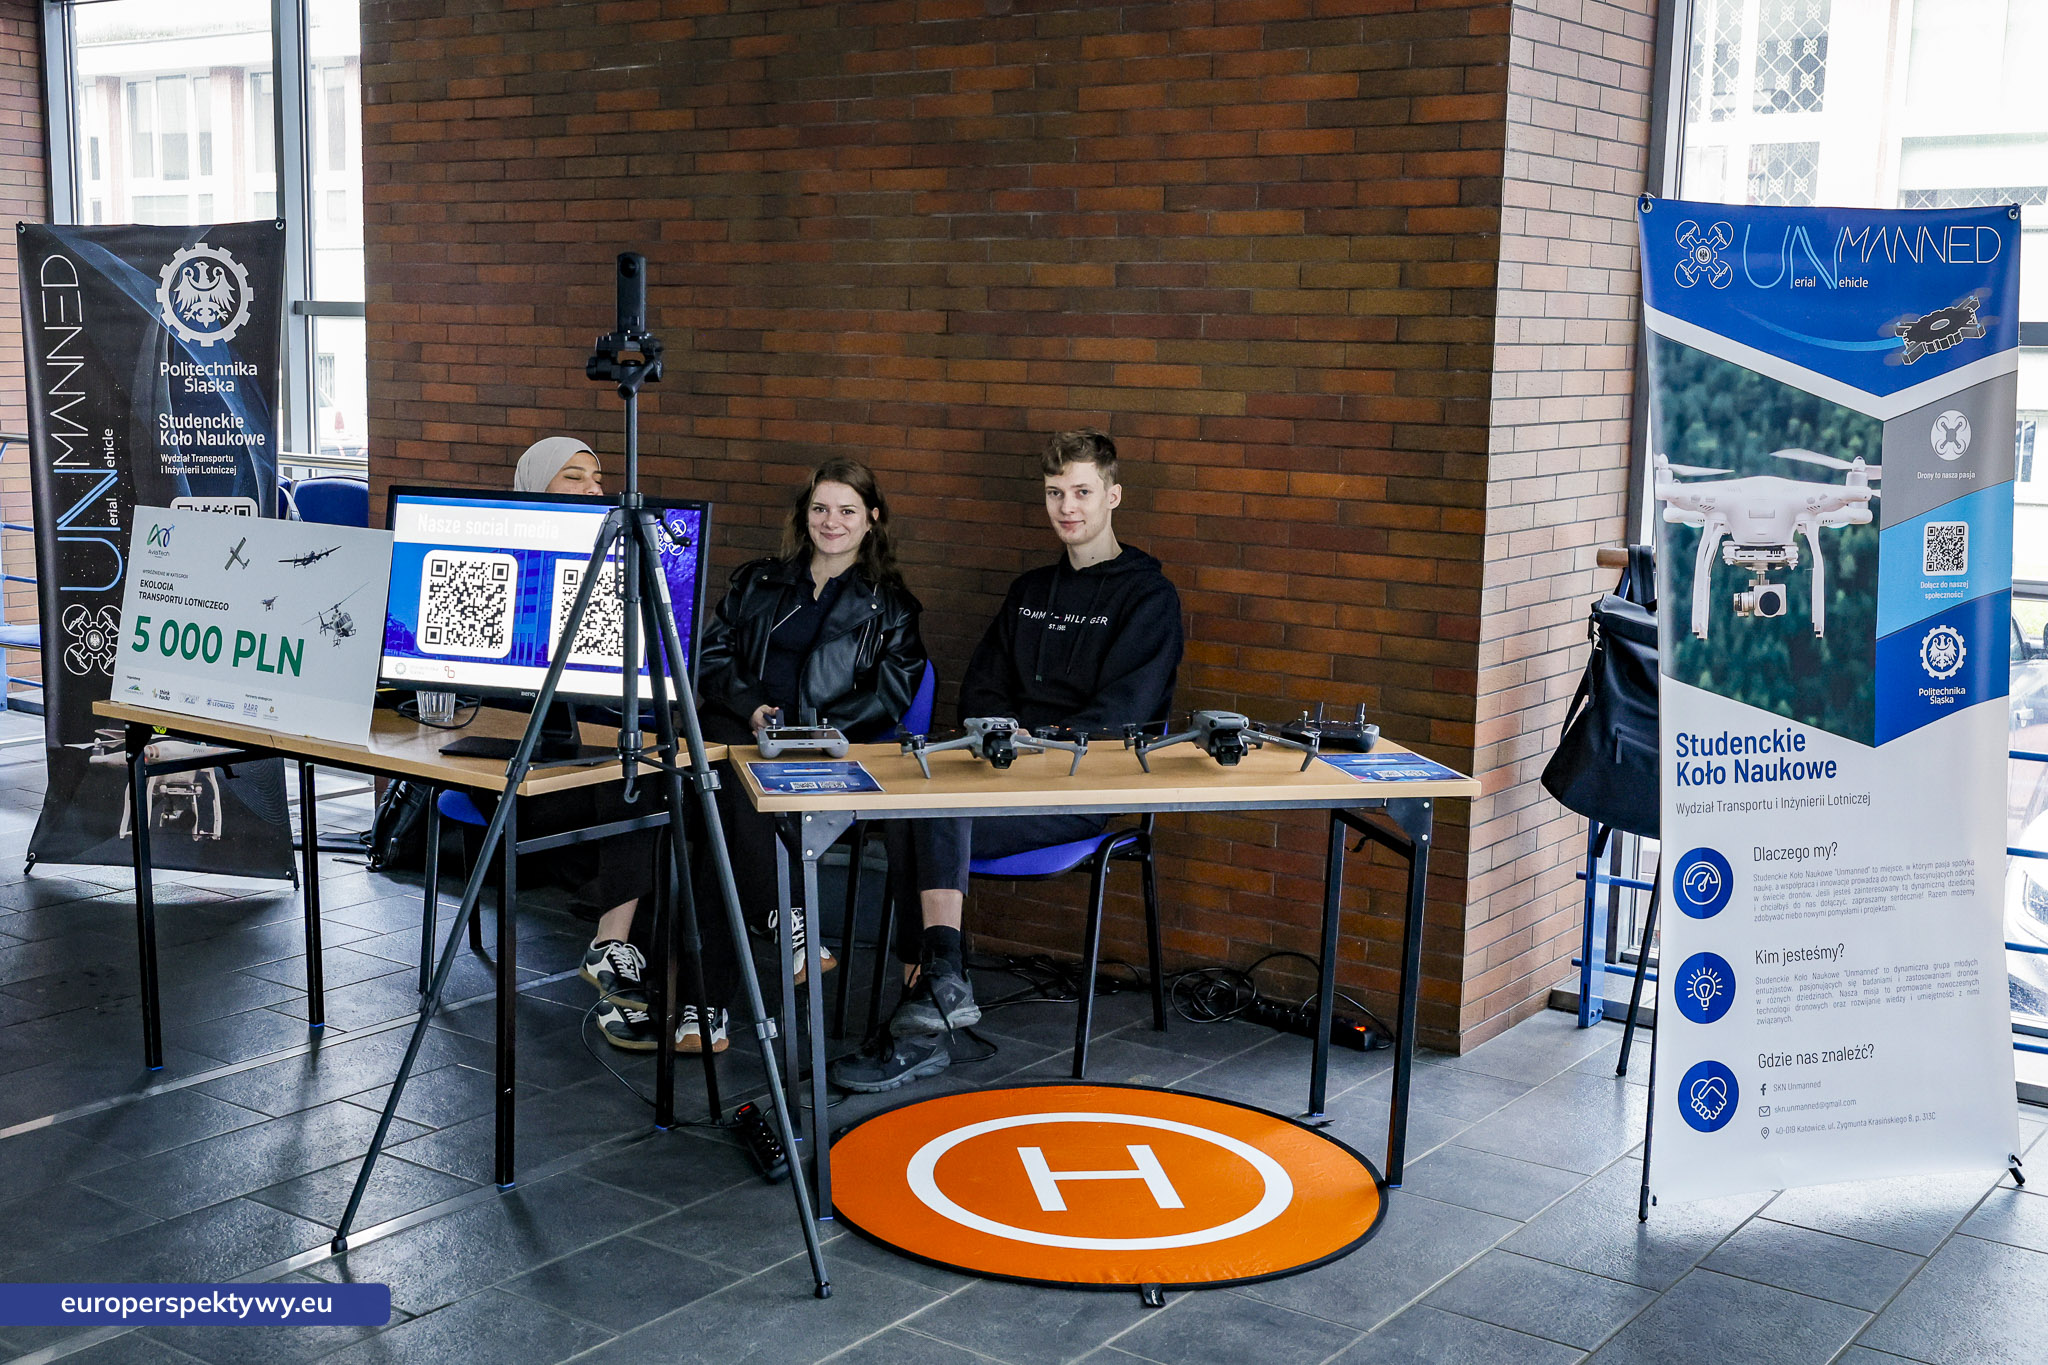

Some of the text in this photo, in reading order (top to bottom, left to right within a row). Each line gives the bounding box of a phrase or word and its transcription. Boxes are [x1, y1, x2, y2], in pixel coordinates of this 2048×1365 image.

[160, 361, 258, 378] Politechnika
[184, 377, 235, 394] Śląska
[159, 412, 244, 430] Studenckie
[160, 430, 266, 447] Koło Naukowe
[160, 453, 234, 465] Wydział Transportu
[164, 464, 200, 476] Inżynierii
[201, 465, 238, 476] Lotniczej
[1917, 472, 1976, 481] Drony to nasza pasja
[416, 512, 560, 540] Nasze social media
[140, 579, 174, 592] EKOLOGIA
[1920, 580, 1969, 590] Dołącz do naszej
[138, 591, 230, 611] TRANSPORTU LOTNICZEGO
[1925, 590, 1964, 600] społeczności
[1064, 614, 1108, 626] HILFGER
[132, 615, 304, 678] 5 000 PLN
[1918, 687, 1966, 697] Politechnika
[1930, 695, 1954, 705] Śląska
[1676, 728, 1806, 758] Studenckie
[1676, 756, 1837, 787] Koło Naukowe
[1676, 801, 1714, 817] Wydział
[1717, 800, 1773, 814] Transportu
[1781, 794, 1825, 811] Inżynierii
[1828, 792, 1871, 806] Lotniczej
[1754, 842, 1838, 862] Dlaczego my?
[1755, 943, 1845, 966] Kim jesteśmy?
[1758, 1044, 1874, 1068] Gdzie nas znaleźć?
[1773, 1080, 1821, 1092] SKN Unmanned
[1016, 1144, 1186, 1212] H
